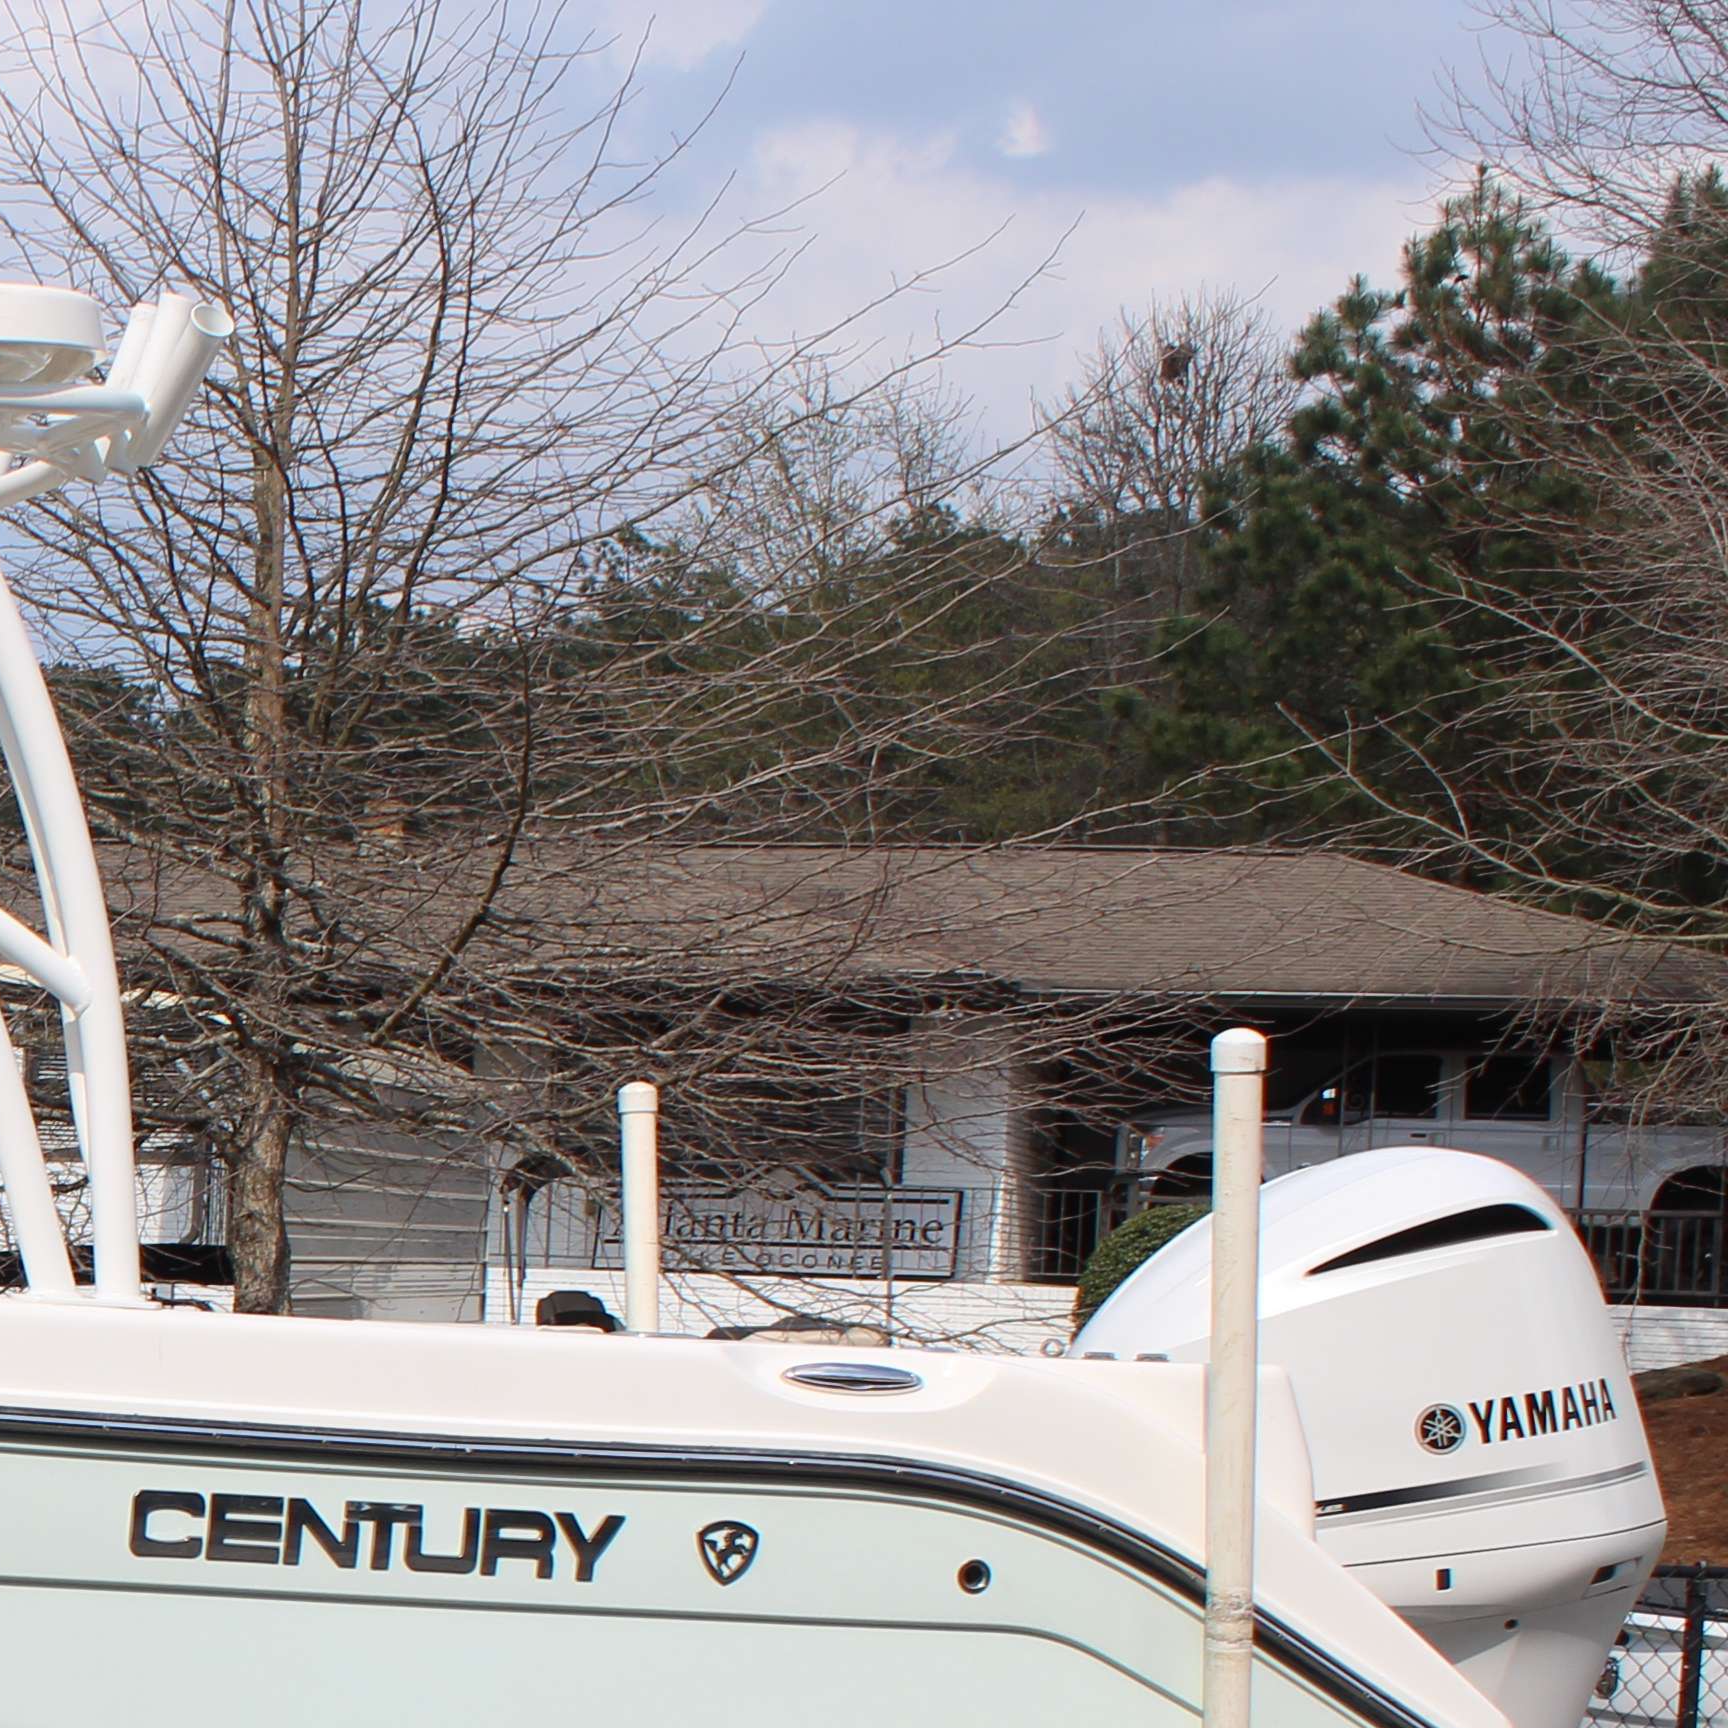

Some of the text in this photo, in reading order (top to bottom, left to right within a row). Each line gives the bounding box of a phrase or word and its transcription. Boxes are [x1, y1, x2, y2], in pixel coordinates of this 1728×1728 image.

[783, 1206, 943, 1244] Marine
[1467, 1378, 1617, 1445] YAMAHA
[128, 1489, 626, 1582] CENTURY
